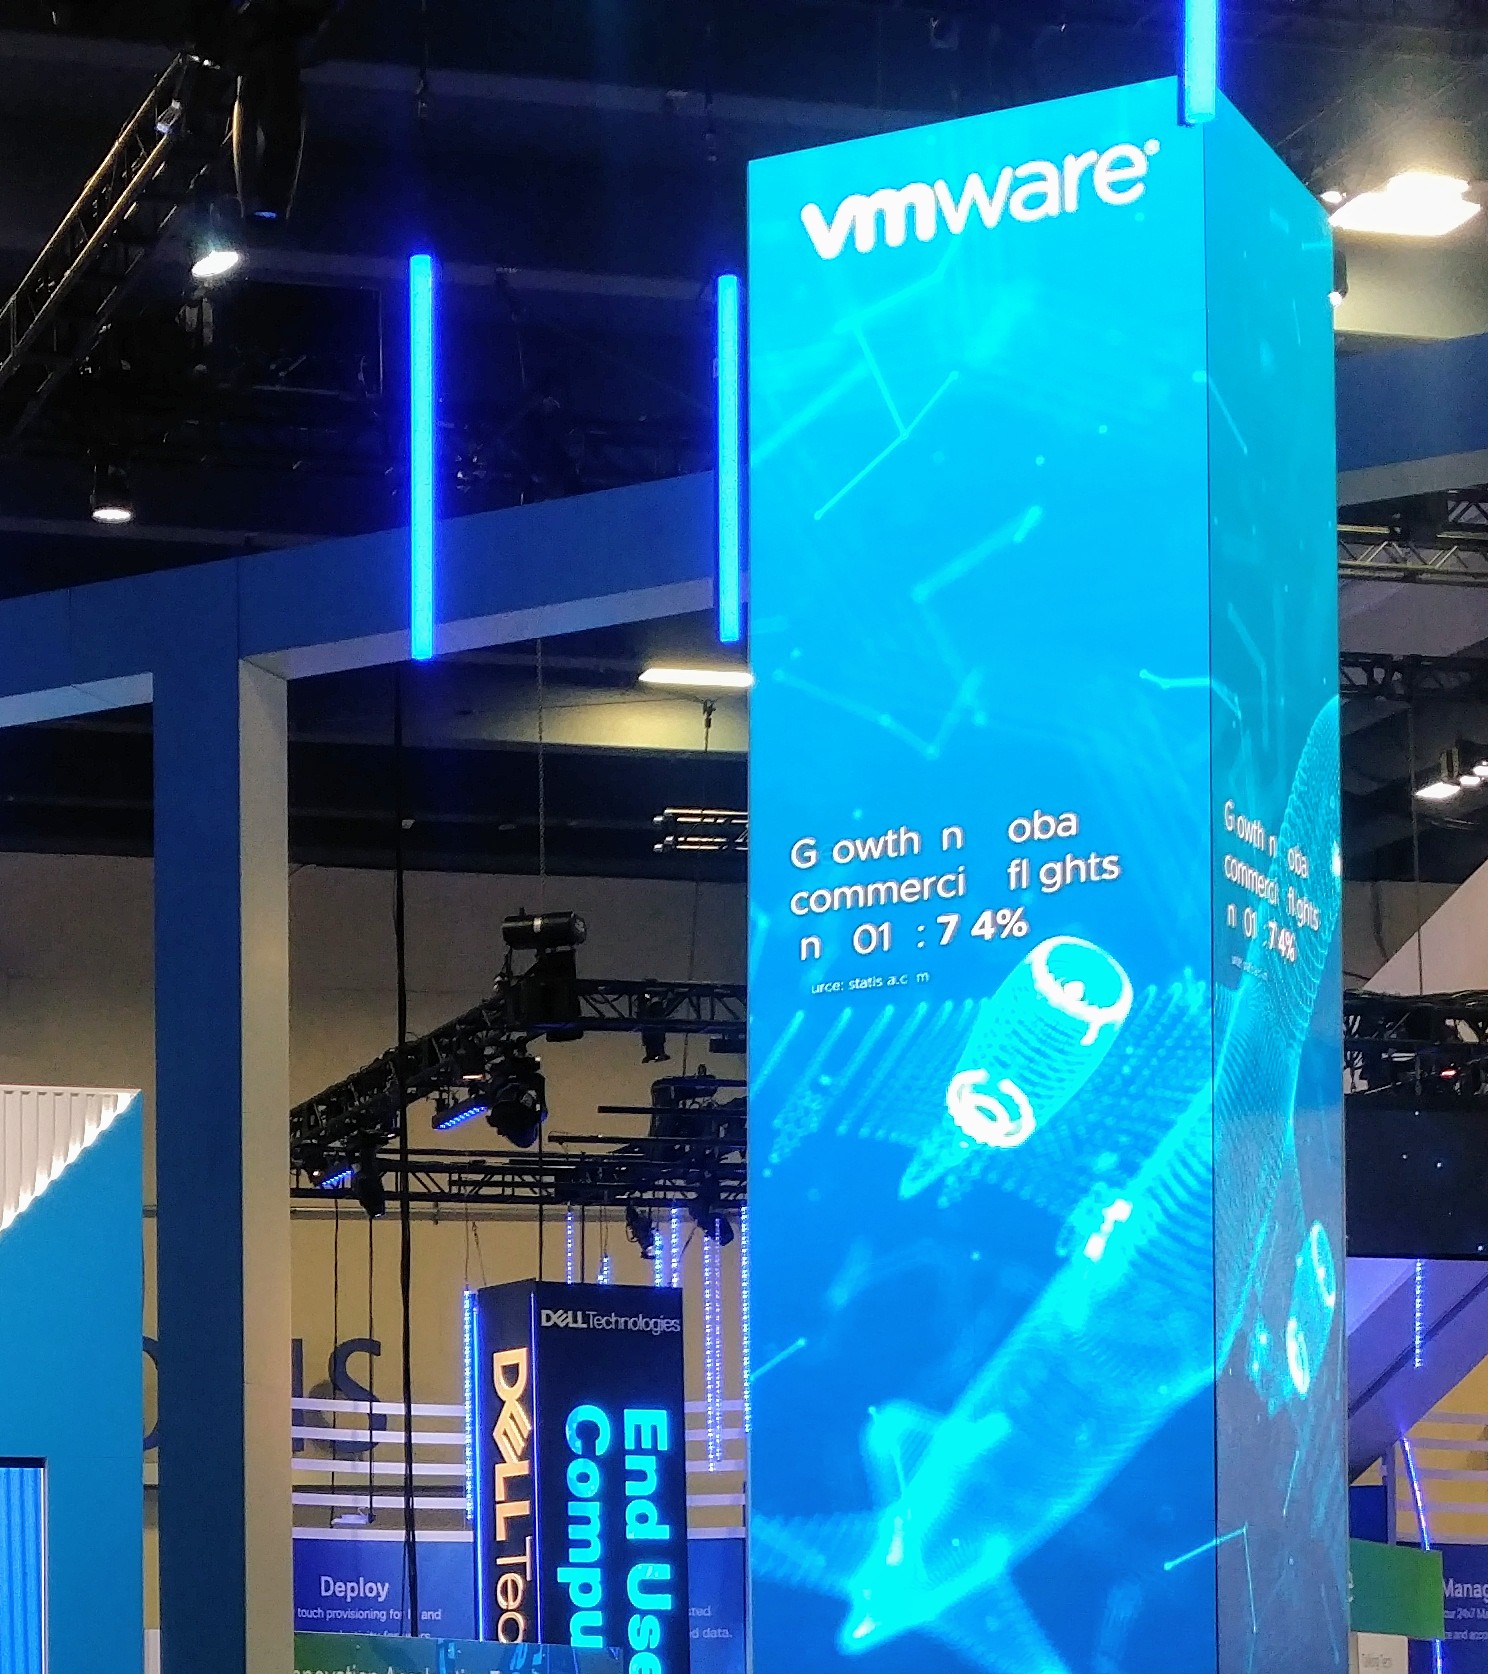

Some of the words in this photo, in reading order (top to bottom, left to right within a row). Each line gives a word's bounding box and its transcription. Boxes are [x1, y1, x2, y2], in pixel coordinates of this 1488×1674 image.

[624, 1407, 671, 1540] End
[557, 1404, 612, 1649] Compu
[297, 1607, 324, 1619] touch
[326, 1607, 386, 1622] provisioning
[421, 1608, 442, 1620] and
[320, 1575, 389, 1602] Deploy
